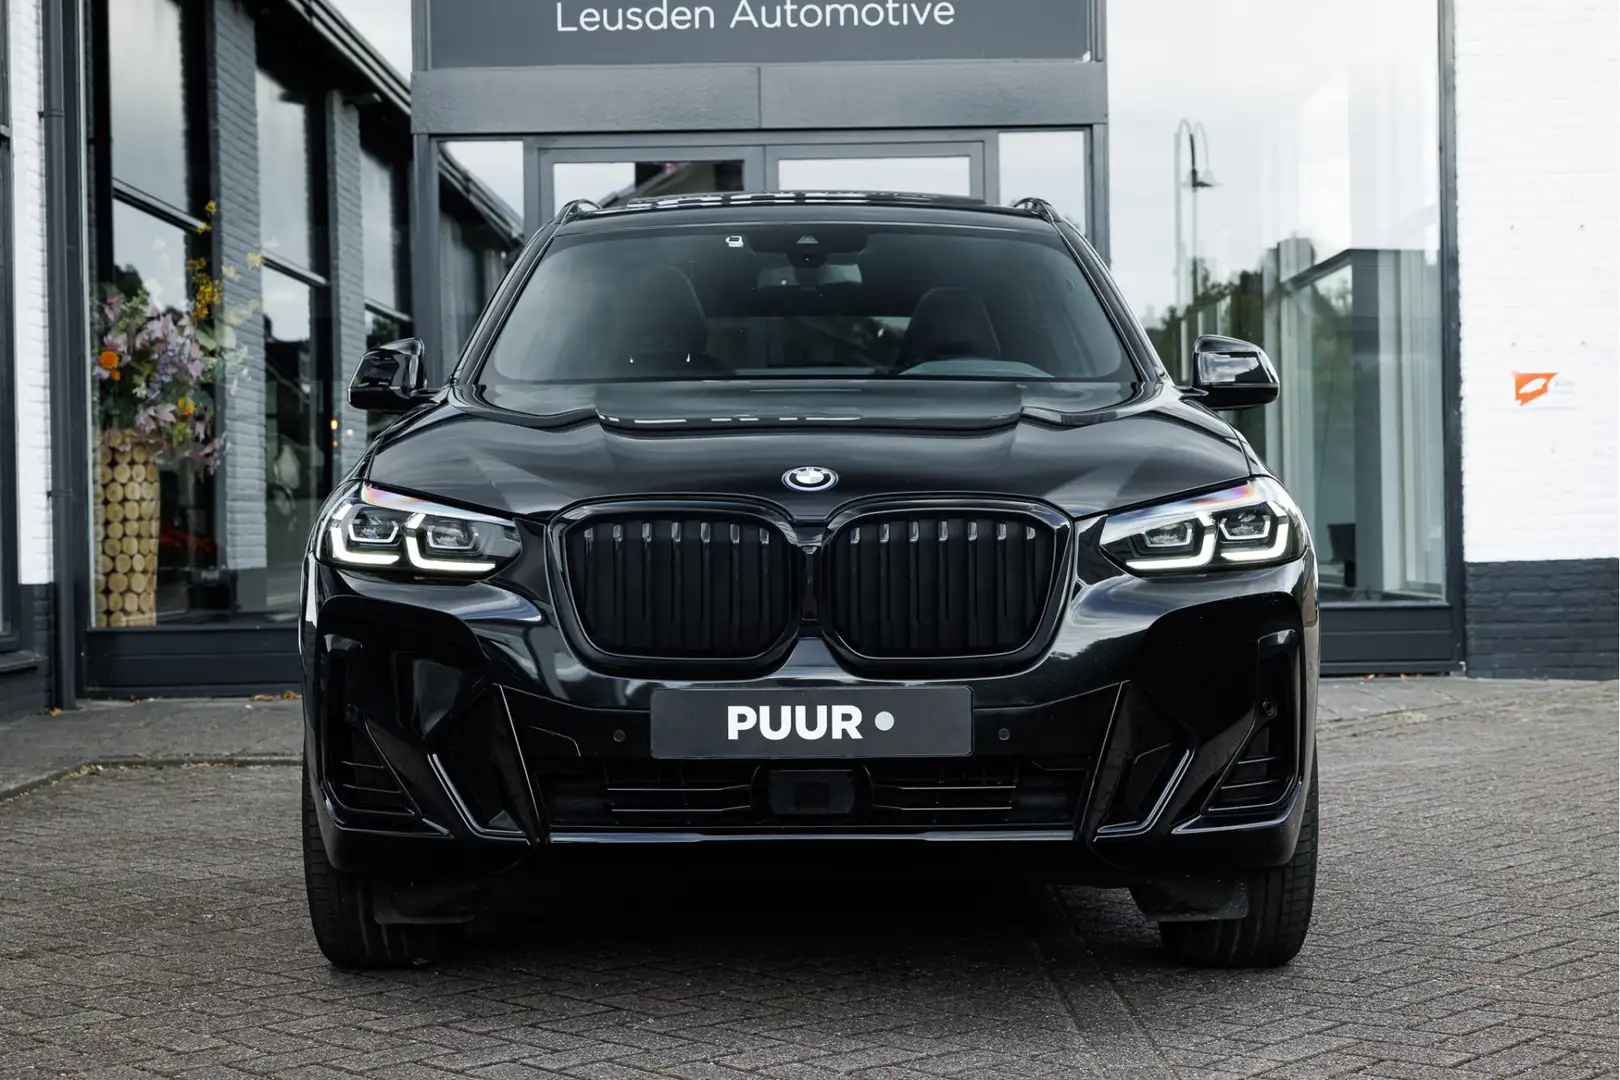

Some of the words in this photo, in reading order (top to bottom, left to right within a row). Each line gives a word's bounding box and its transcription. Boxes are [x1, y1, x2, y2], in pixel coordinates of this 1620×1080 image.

[556, 0, 716, 32] Leusden
[729, 0, 956, 29] Automotive
[727, 705, 864, 741] PUUR
